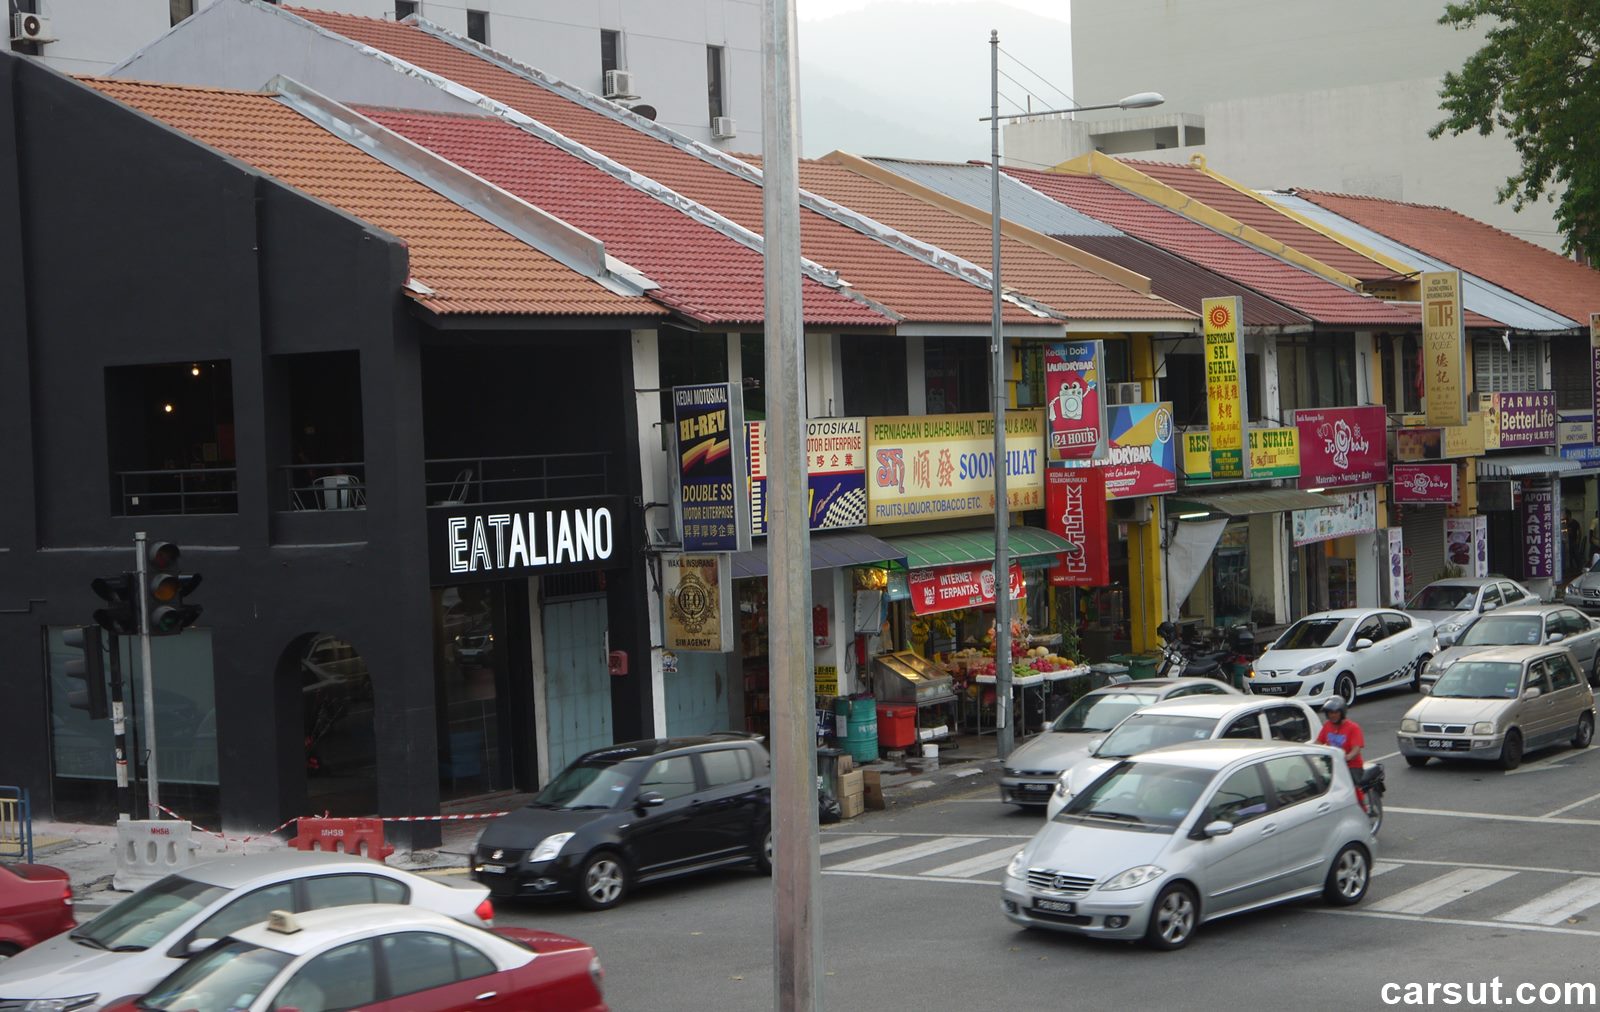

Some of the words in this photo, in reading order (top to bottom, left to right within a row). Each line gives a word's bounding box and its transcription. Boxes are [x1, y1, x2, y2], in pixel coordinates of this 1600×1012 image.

[1206, 332, 1235, 345] RESTORAN
[1428, 331, 1455, 342] TUCK
[1045, 348, 1067, 357] Kedai
[1069, 346, 1088, 355] Dobi
[1213, 345, 1229, 359] SRI
[1432, 340, 1453, 351] KEE
[1047, 360, 1095, 373] LAUNDRYBAR
[1208, 360, 1236, 375] SURIYA
[675, 391, 693, 406] KEDAI
[693, 387, 728, 405] MOTOSIKAL
[1501, 395, 1554, 409] FARMASI
[679, 409, 726, 441] HI-REV
[1501, 409, 1554, 431] BetterLife
[874, 423, 921, 440] PERNIAGAAN
[924, 421, 976, 438] BUAH-BUAHAN,
[1014, 419, 1019, 433] &
[1020, 418, 1038, 433] ARAK
[806, 437, 823, 452] OTOR
[824, 436, 861, 451] ENTERPRISE
[1054, 434, 1066, 446] 24
[1068, 432, 1096, 445] HOUR
[1262, 431, 1294, 448] SURIYA
[1501, 432, 1533, 443] Pharmacy
[1315, 475, 1338, 485] Maternity
[1341, 473, 1358, 482] Nursing
[1361, 471, 1372, 480] Baby
[682, 483, 718, 502] DOUBLE
[720, 483, 733, 500] SS
[967, 496, 983, 509] ETC.
[683, 506, 702, 521] MOTOR
[702, 505, 734, 520] ENTERPRISE
[448, 507, 612, 573] EATALIANO
[1526, 504, 1542, 576] FARMASI
[1544, 532, 1552, 575] PHARMACY
[939, 571, 972, 585] INTERNET
[939, 584, 979, 600] TERPANTAS
[686, 638, 711, 648] AGENCY
[150, 827, 170, 836] MHSB
[321, 829, 344, 837] MHSB
